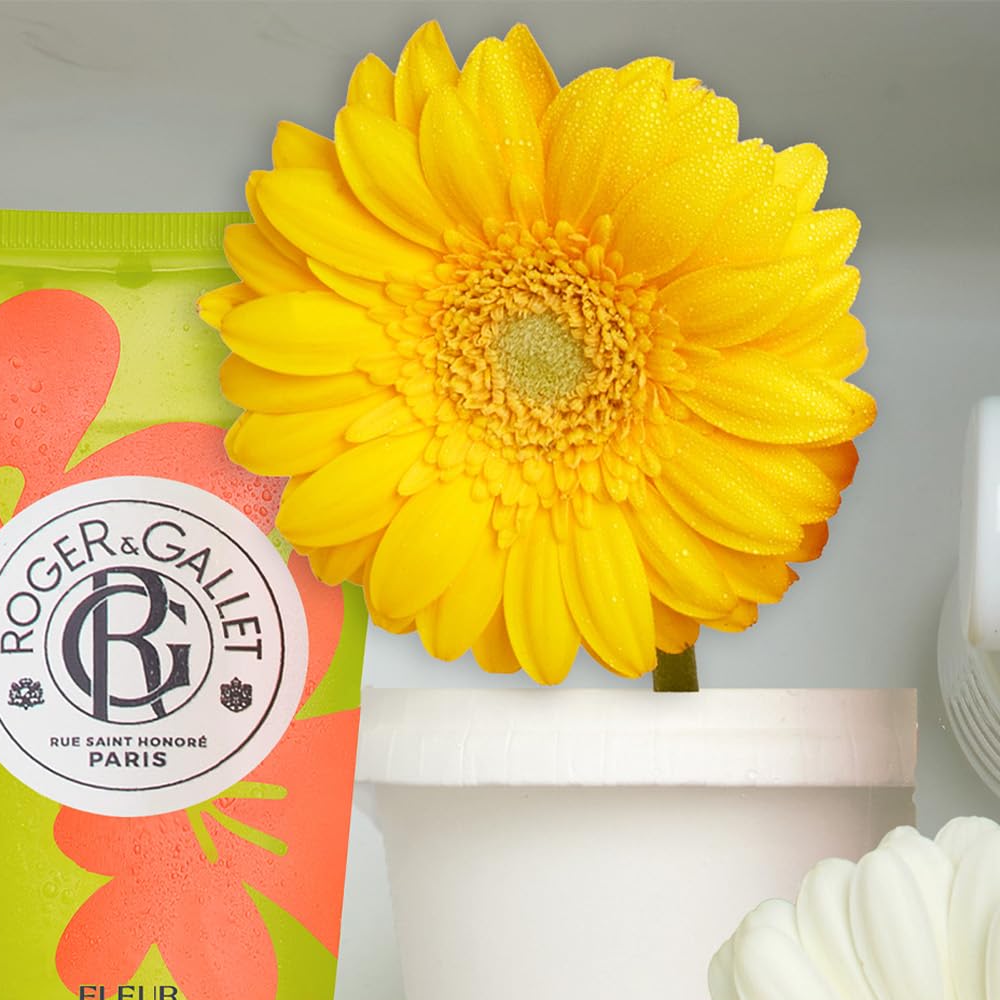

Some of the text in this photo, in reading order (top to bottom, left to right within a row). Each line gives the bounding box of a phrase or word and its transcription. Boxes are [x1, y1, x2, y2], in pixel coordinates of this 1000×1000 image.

[50, 735, 208, 748] RUE SAINT HONORÉ
[89, 751, 168, 767] PARIS
